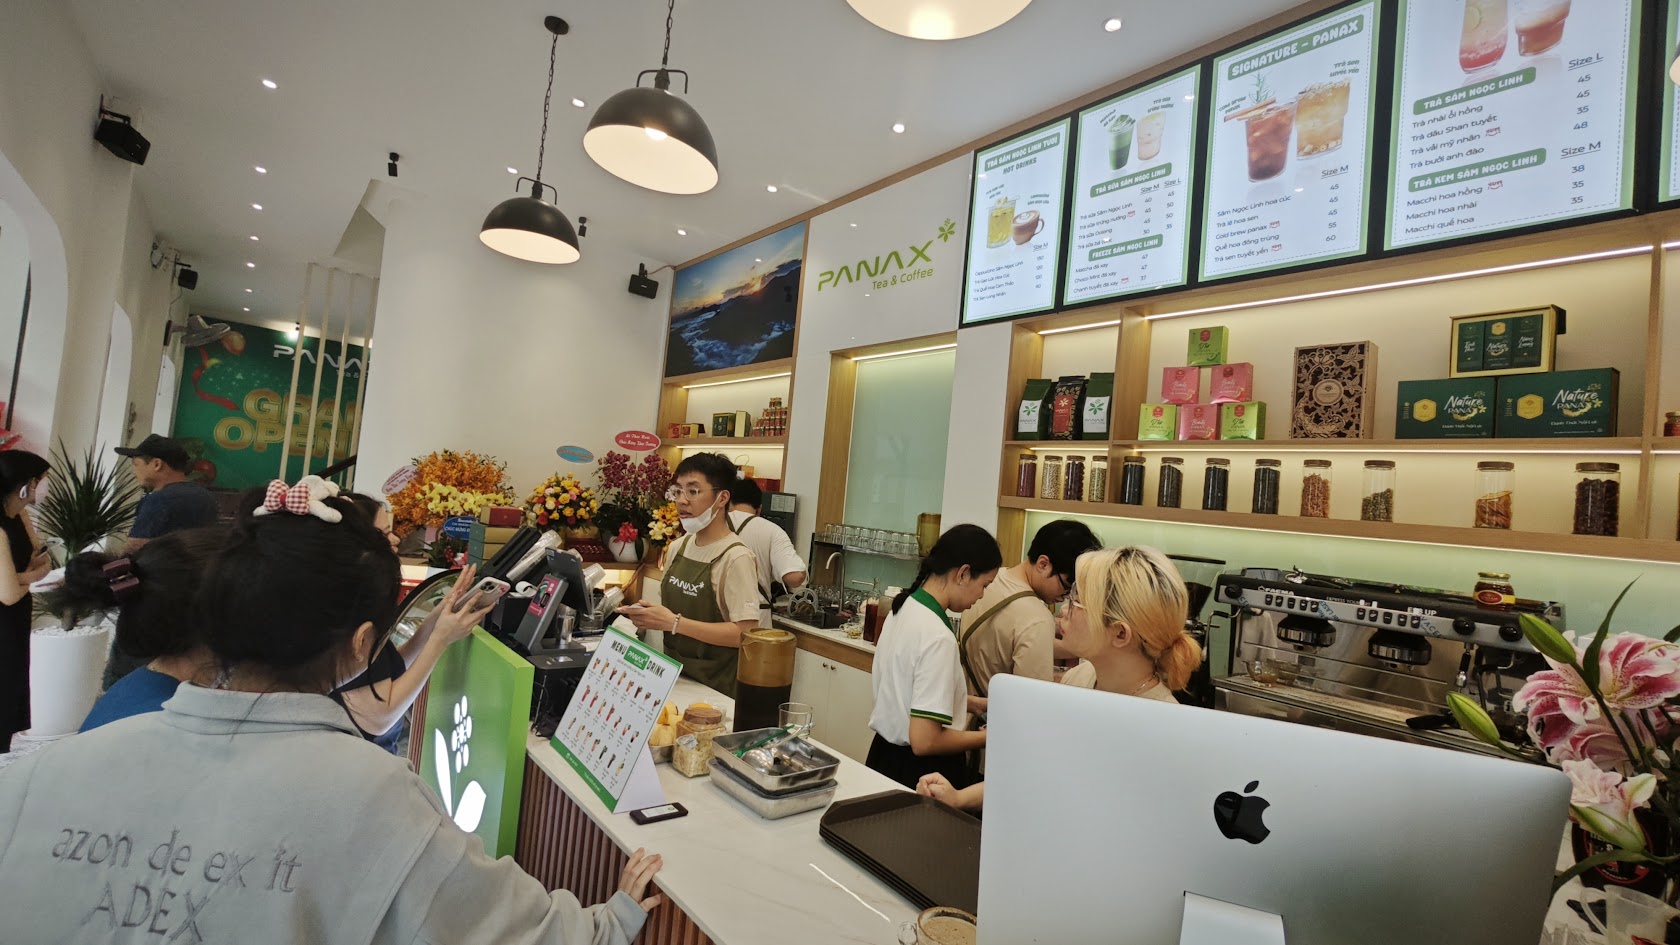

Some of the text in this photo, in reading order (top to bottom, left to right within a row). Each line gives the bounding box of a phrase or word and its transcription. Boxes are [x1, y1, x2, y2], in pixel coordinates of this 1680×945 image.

[1232, 20, 1358, 76] SIGNATURE PANAX
[1569, 56, 1593, 69] Size
[1499, 75, 1523, 88] LINH
[1578, 74, 1591, 83] 45
[1577, 90, 1590, 98] 45
[1577, 106, 1589, 114] 35
[1412, 120, 1425, 128] Trà
[1574, 121, 1588, 130] 48
[1412, 134, 1424, 142] Trà
[1446, 123, 1468, 133] Shan
[1411, 147, 1423, 155] Trà
[1561, 141, 1601, 156] Size M
[1003, 157, 1037, 174] HOT DRINKS
[1410, 161, 1422, 169] Trà
[1446, 151, 1463, 161] anh
[1151, 168, 1165, 178] LINH
[1322, 169, 1338, 177] Size
[1435, 174, 1454, 184] KEM
[1512, 155, 1537, 167] LINH
[1572, 165, 1585, 173] 38
[1250, 201, 1263, 209] Linh
[1407, 195, 1437, 207] Macchi
[1571, 196, 1583, 204] 35
[1406, 209, 1435, 220] Macchi
[1438, 206, 1455, 214] hoa
[1216, 225, 1267, 240] Cold brew panax
[1405, 222, 1435, 234] Macchi
[1144, 239, 1158, 247] LINH
[818, 240, 934, 291] PANAX
[872, 268, 934, 290] Tea & Coffee
[273, 344, 365, 370] PANA
[1444, 395, 1483, 410] Nature
[1552, 388, 1598, 406] Nature
[214, 417, 353, 460] OPEN
[669, 576, 698, 592] PANAX
[611, 640, 627, 655] MENU
[647, 660, 665, 678] DRINK
[148, 828, 192, 876] de
[79, 881, 211, 942] ADEX
